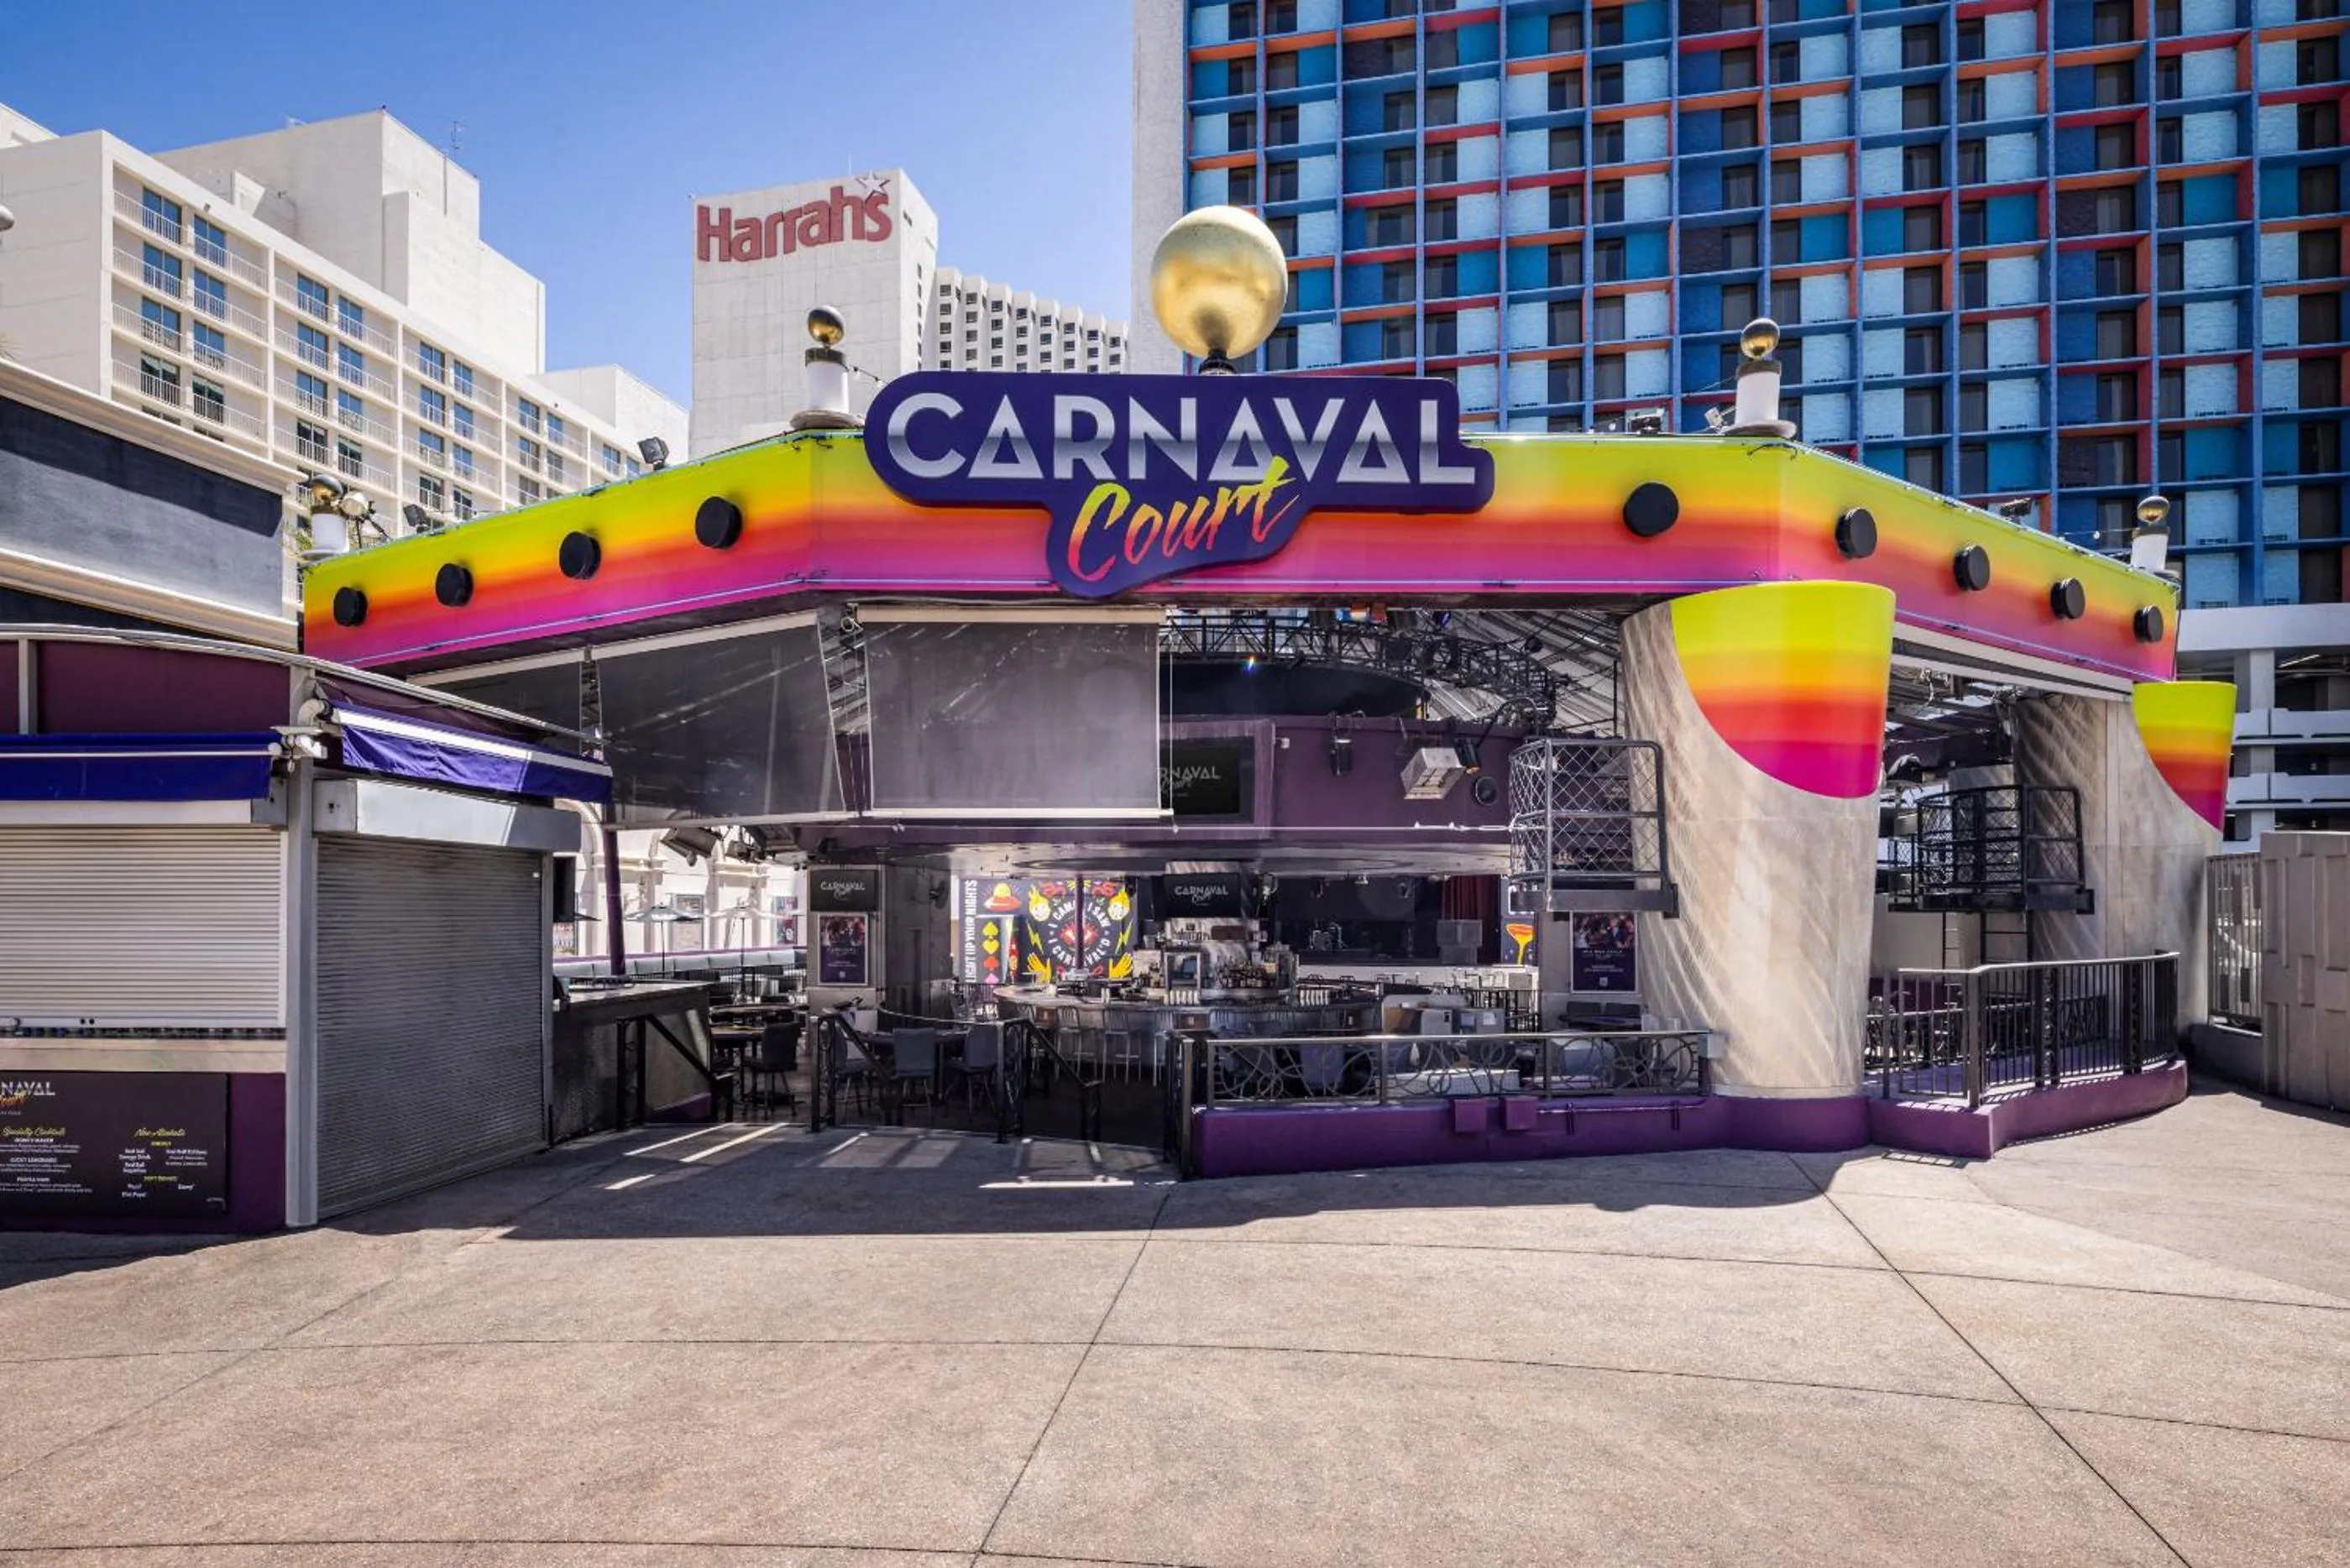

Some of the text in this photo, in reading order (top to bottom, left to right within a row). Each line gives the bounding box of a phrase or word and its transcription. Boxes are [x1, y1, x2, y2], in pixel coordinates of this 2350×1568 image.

[887, 392, 1475, 484] CARNAVAL
[1067, 456, 1300, 582] Court
[820, 881, 865, 890] CARNAVAL
[965, 880, 977, 916] NIGHTS
[1175, 885, 1228, 895] CARNAVAL
